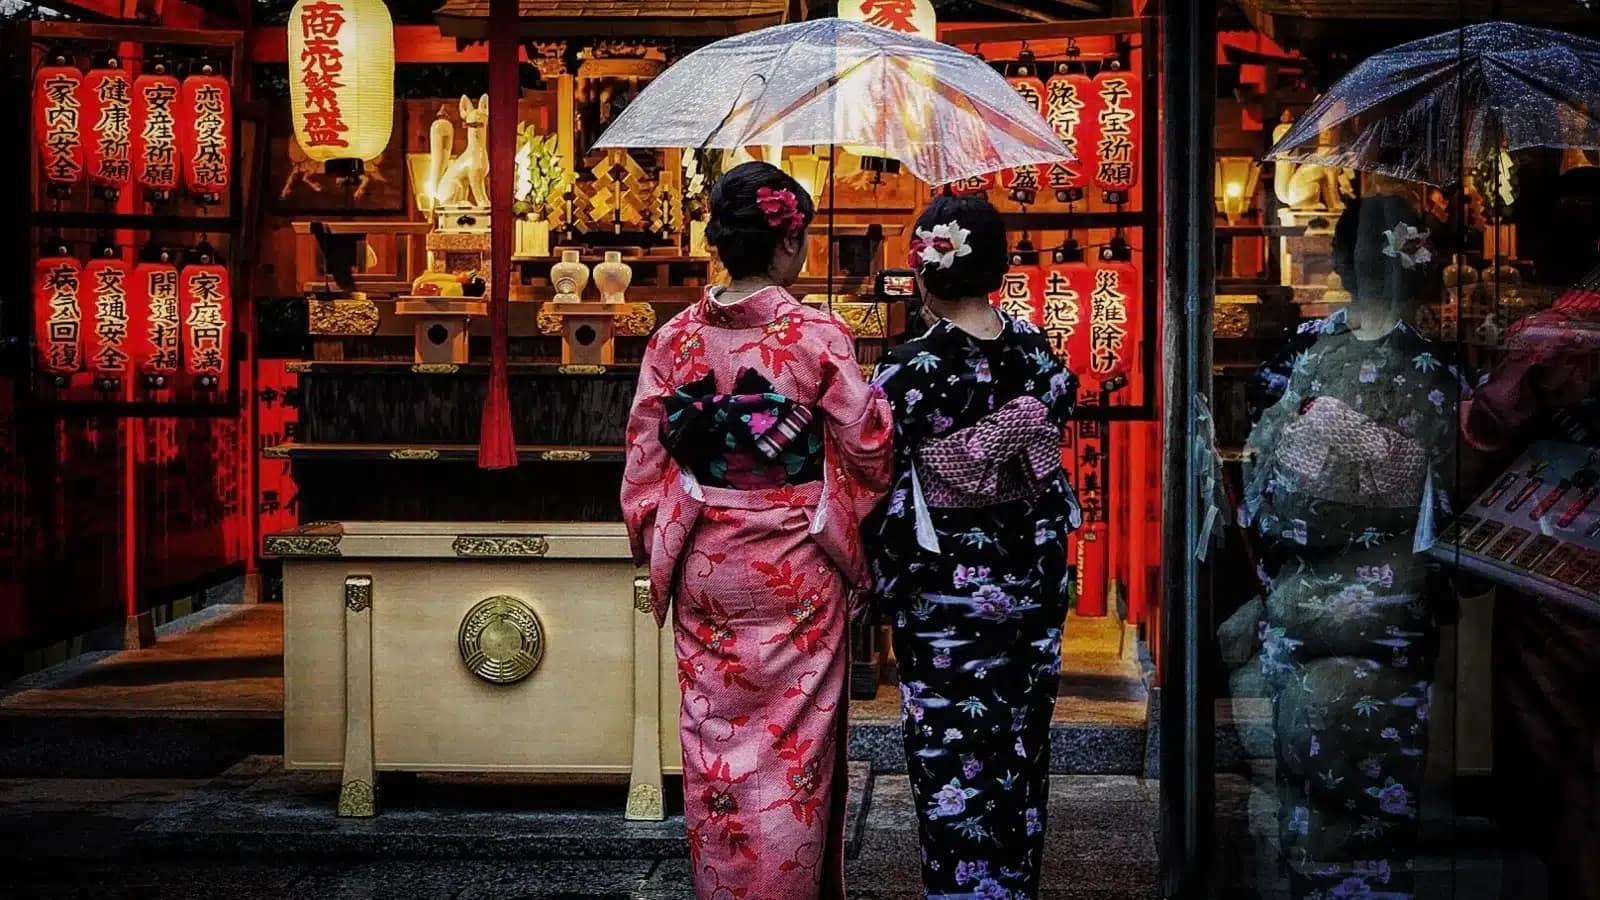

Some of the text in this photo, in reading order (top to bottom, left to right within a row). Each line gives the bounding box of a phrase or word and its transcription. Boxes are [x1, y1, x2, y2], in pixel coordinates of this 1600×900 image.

[301, 1, 349, 148] 商売繁盛
[44, 76, 81, 182] 家内安全
[95, 77, 132, 183] 健康祈願
[141, 84, 177, 186] 安産祈願
[194, 86, 228, 186] 恋愛成就
[1098, 79, 1135, 186] 子宝祈願
[47, 265, 81, 369] 病気回復
[96, 268, 129, 372] 交通安全
[148, 271, 179, 370] 開運招福
[186, 272, 227, 372] 家庭円満
[1091, 269, 1127, 373] 災難除け
